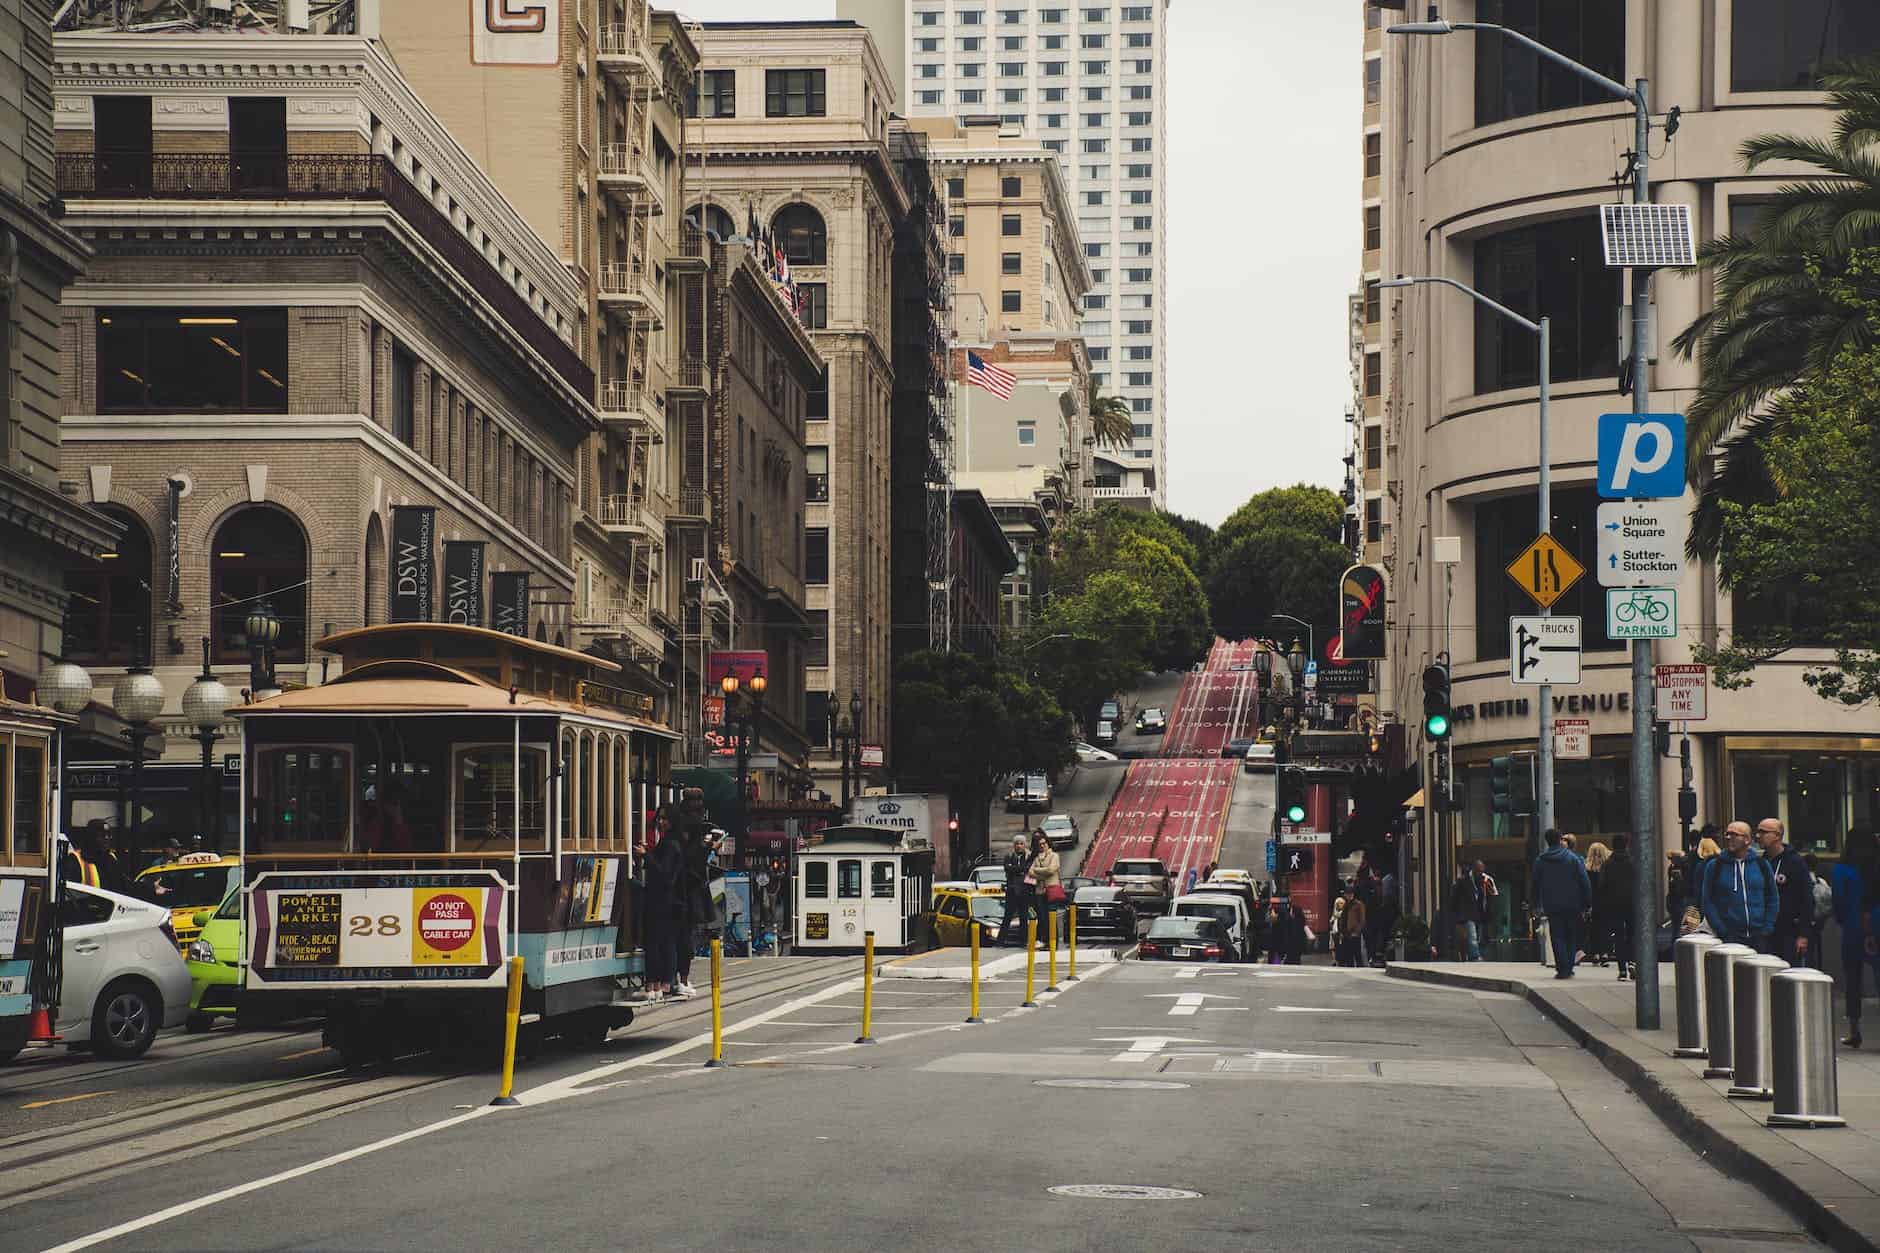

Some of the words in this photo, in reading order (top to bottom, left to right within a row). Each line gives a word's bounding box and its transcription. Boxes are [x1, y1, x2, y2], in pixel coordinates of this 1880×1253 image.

[1611, 422, 1673, 490] P
[1623, 516, 1658, 526] Union
[421, 512, 430, 561] WAREHOUSE
[1623, 528, 1665, 539] Square
[1623, 550, 1665, 560] Sutter-
[398, 541, 418, 596] DSW
[1623, 562, 1678, 572] Stockton
[420, 563, 428, 585] SHOE
[449, 575, 468, 626] DSW
[1540, 625, 1575, 633] TRUCKS
[1616, 626, 1668, 635] PARKING
[1657, 675, 1670, 688] NO
[1671, 677, 1705, 687] STOPPING
[1672, 690, 1691, 699] ANY
[1552, 693, 1630, 713] VENUE
[1671, 701, 1693, 711] TIME
[1564, 743, 1580, 751] TIME
[185, 855, 212, 863] TAXI
[282, 897, 340, 906] POWELL
[430, 902, 443, 910] DO
[445, 902, 465, 910] NOT
[280, 913, 340, 922] MARKET
[349, 915, 401, 936] 28
[280, 935, 299, 945] HYDE
[312, 935, 337, 945] BEACH
[423, 931, 451, 939] CABLE
[452, 931, 470, 939] CAR
[415, 967, 477, 978] WHARF
